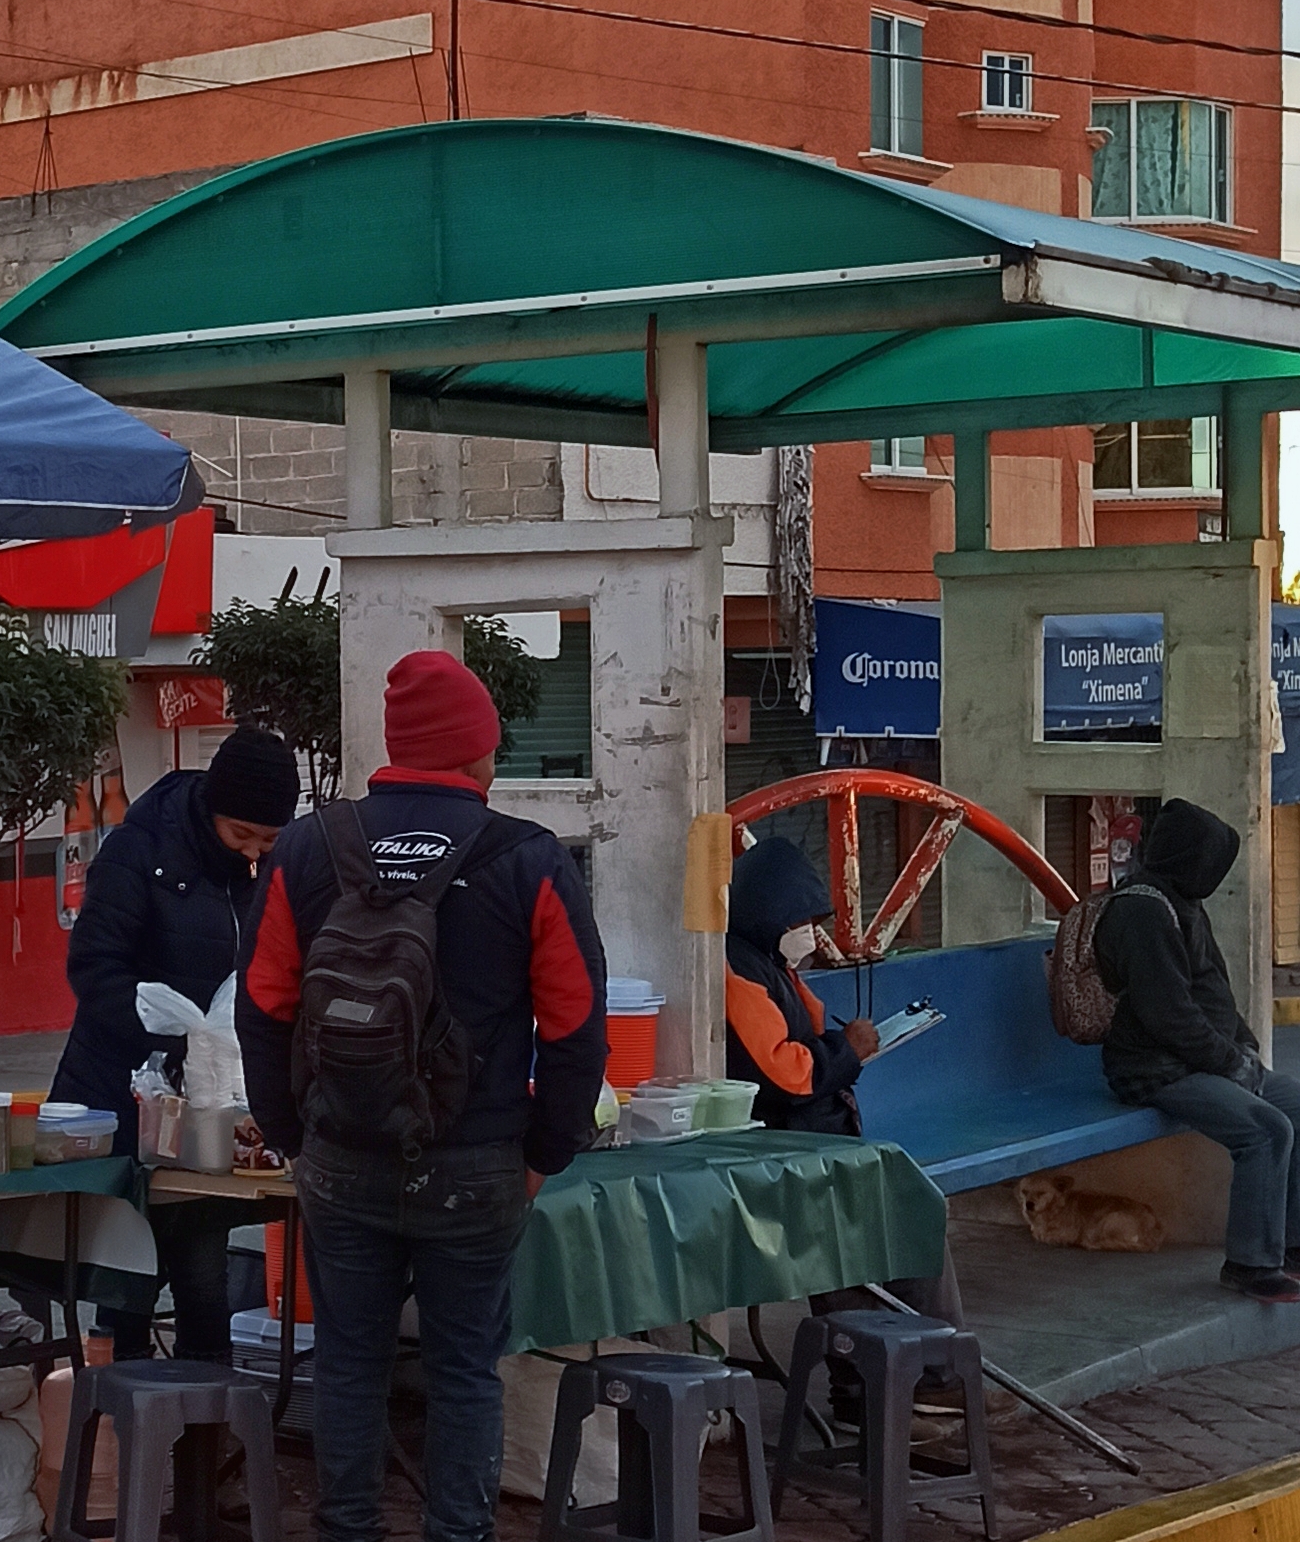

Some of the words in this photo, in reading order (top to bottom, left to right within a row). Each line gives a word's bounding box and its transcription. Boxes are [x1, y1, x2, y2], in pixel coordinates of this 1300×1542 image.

[71, 614, 116, 658] MIGUEL
[841, 652, 939, 687] Corona
[1061, 643, 1100, 673] Lonja
[1102, 639, 1164, 665] Mercanti
[371, 841, 447, 858] ITALIKA
